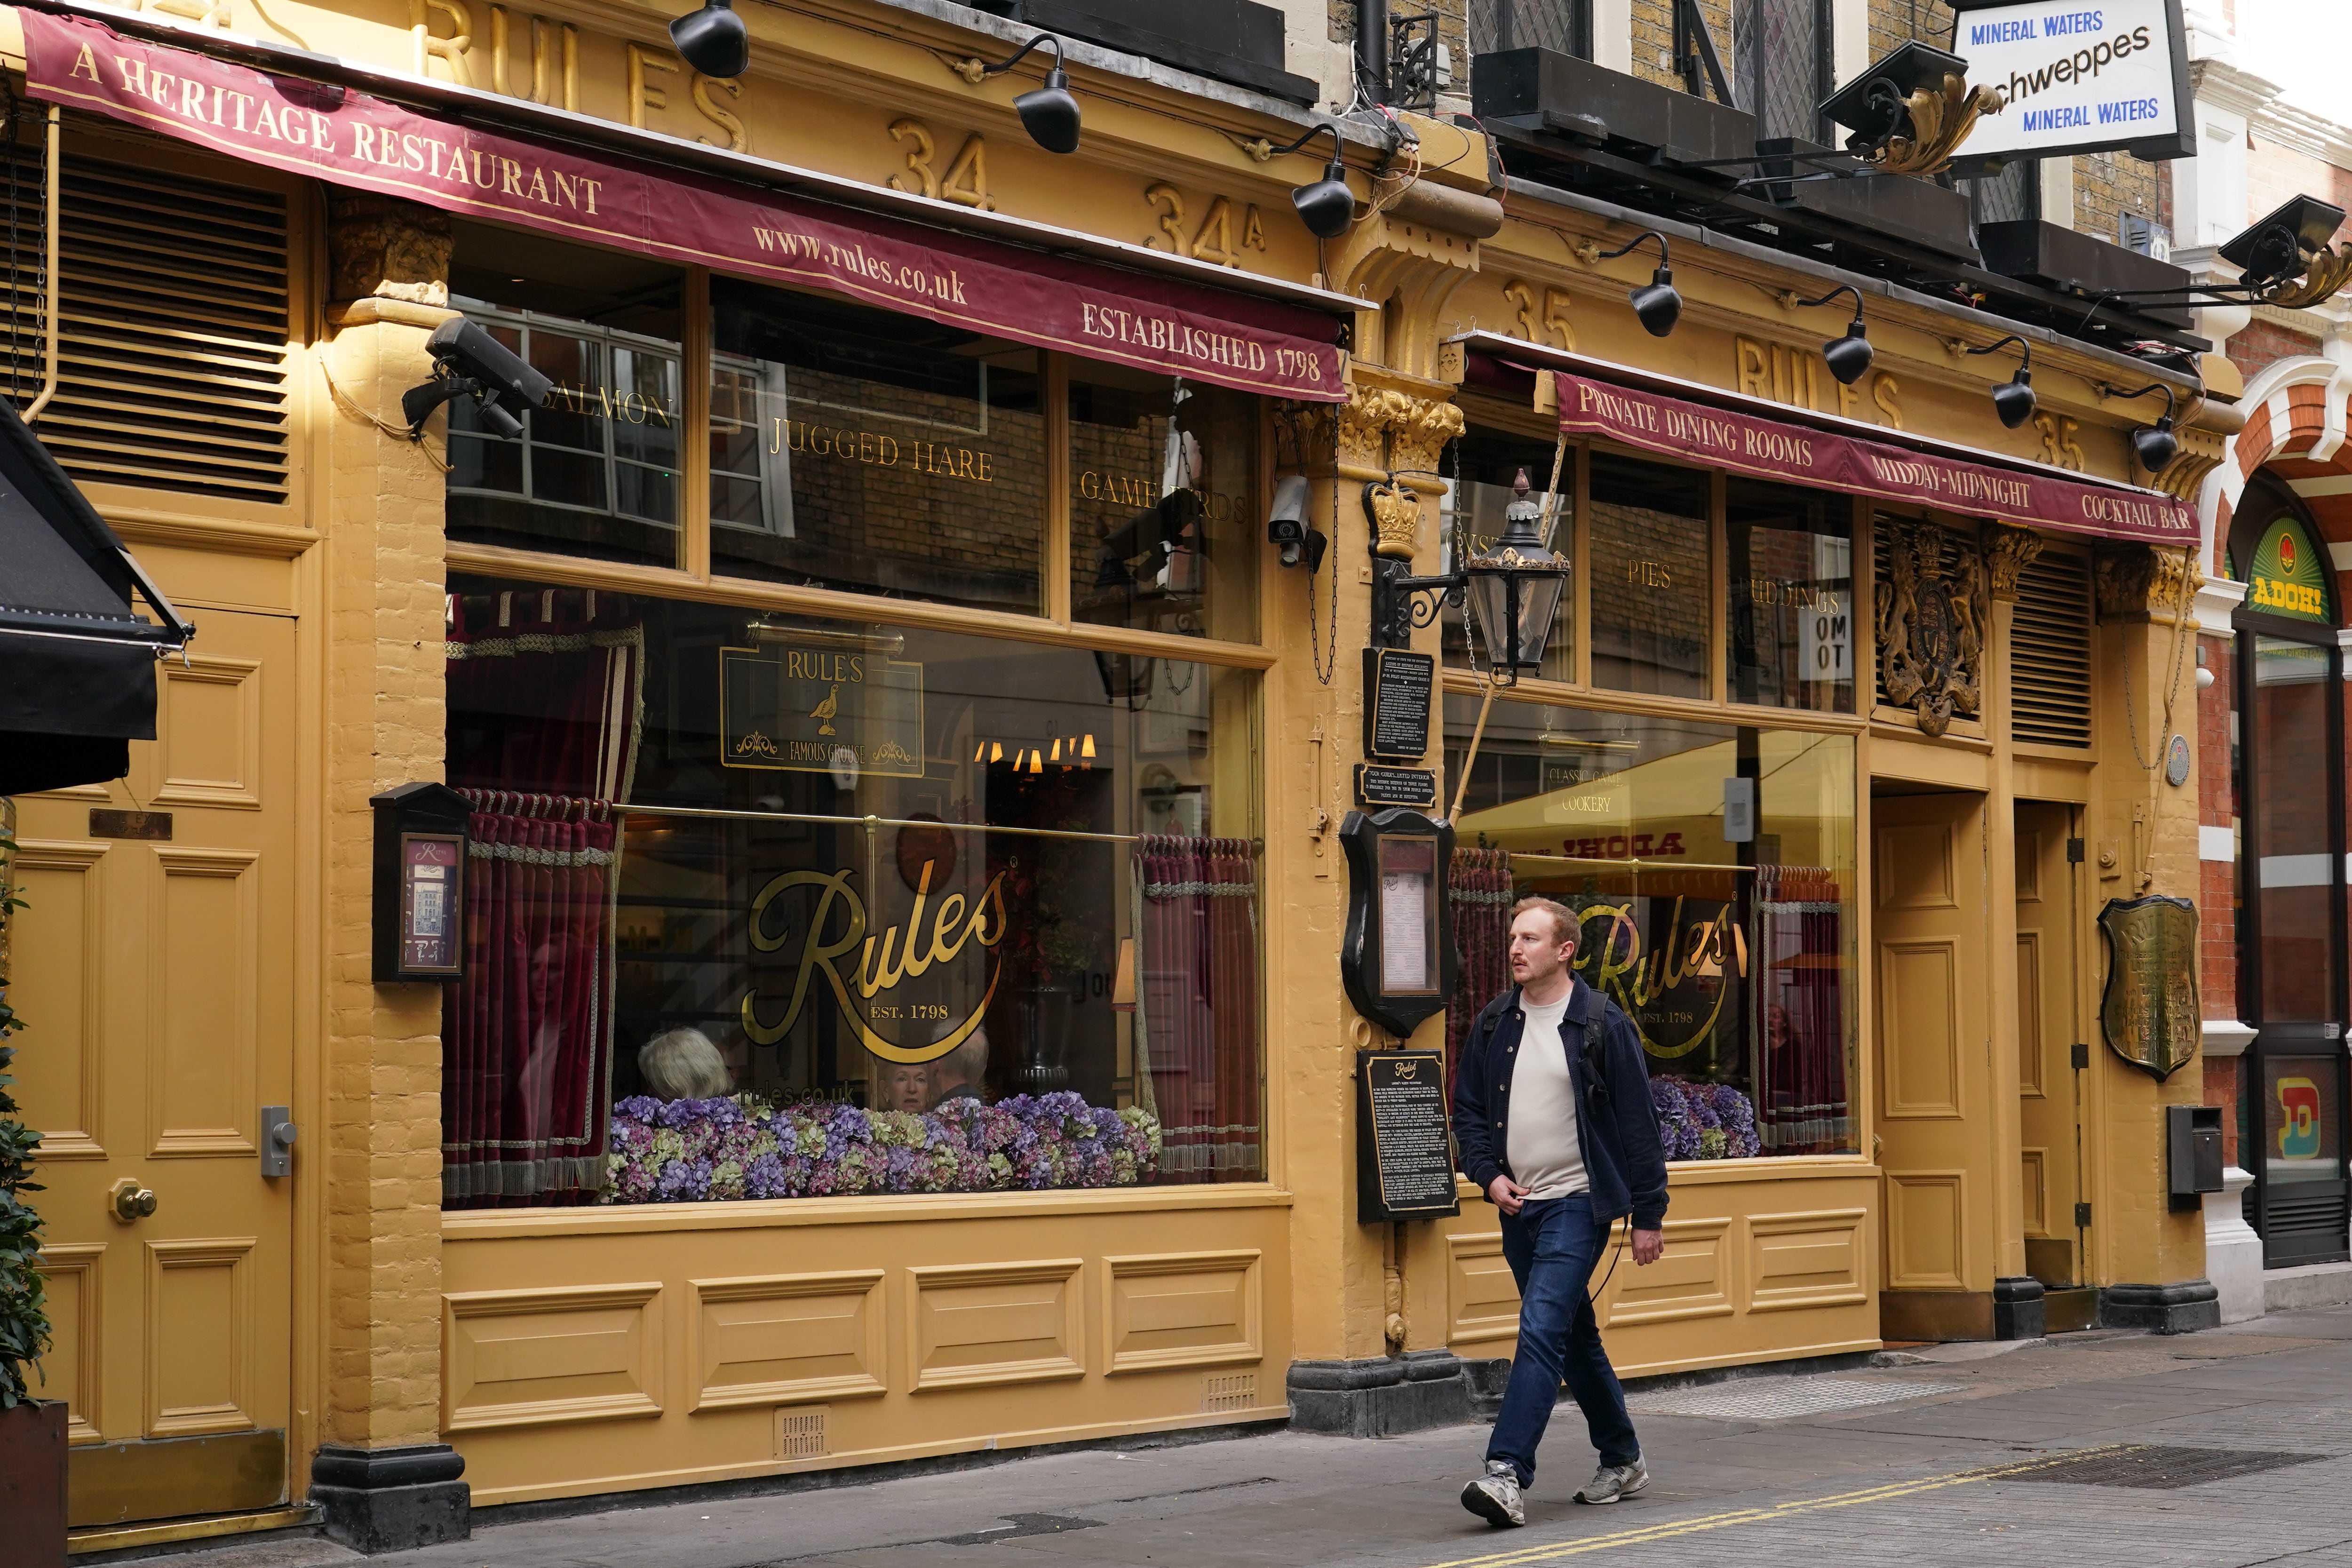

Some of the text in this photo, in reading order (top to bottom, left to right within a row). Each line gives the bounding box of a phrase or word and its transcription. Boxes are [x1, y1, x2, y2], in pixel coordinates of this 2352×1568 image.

[1972, 10, 2103, 45] MINERAL WATERS
[1994, 26, 2151, 105] chweppes
[69, 42, 602, 215] A HERITAGE RESTAURANT
[2024, 98, 2158, 131] MINERAL WATERS
[886, 118, 996, 212] 34
[752, 226, 968, 305] www.rules.co.uk
[1504, 280, 1576, 352] 35
[1082, 302, 1320, 381] ESTABLISHED 1798
[1578, 383, 1812, 467] PRIVATE DINING ROOMS
[2034, 411, 2085, 473] 35
[770, 417, 993, 482] JUGGED HARE
[1081, 471, 1158, 509] GAME
[2082, 494, 2156, 527] COCKTAIL
[2160, 506, 2192, 530] BAR
[1628, 559, 1671, 589] PIES
[2254, 578, 2321, 615] ADOH!
[790, 741, 866, 764] FAMOUS GROUSE
[1549, 768, 1623, 787] CLASSIC GAME
[1562, 796, 1611, 812] COOKERY
[415, 842, 443, 862] R
[741, 859, 1008, 1065] Rules
[1573, 894, 1731, 1059] Rules
[870, 1004, 949, 1019] EST. 1798
[1644, 1011, 1693, 1024] EST. 1798
[740, 1079, 855, 1106] rules.co.uk
